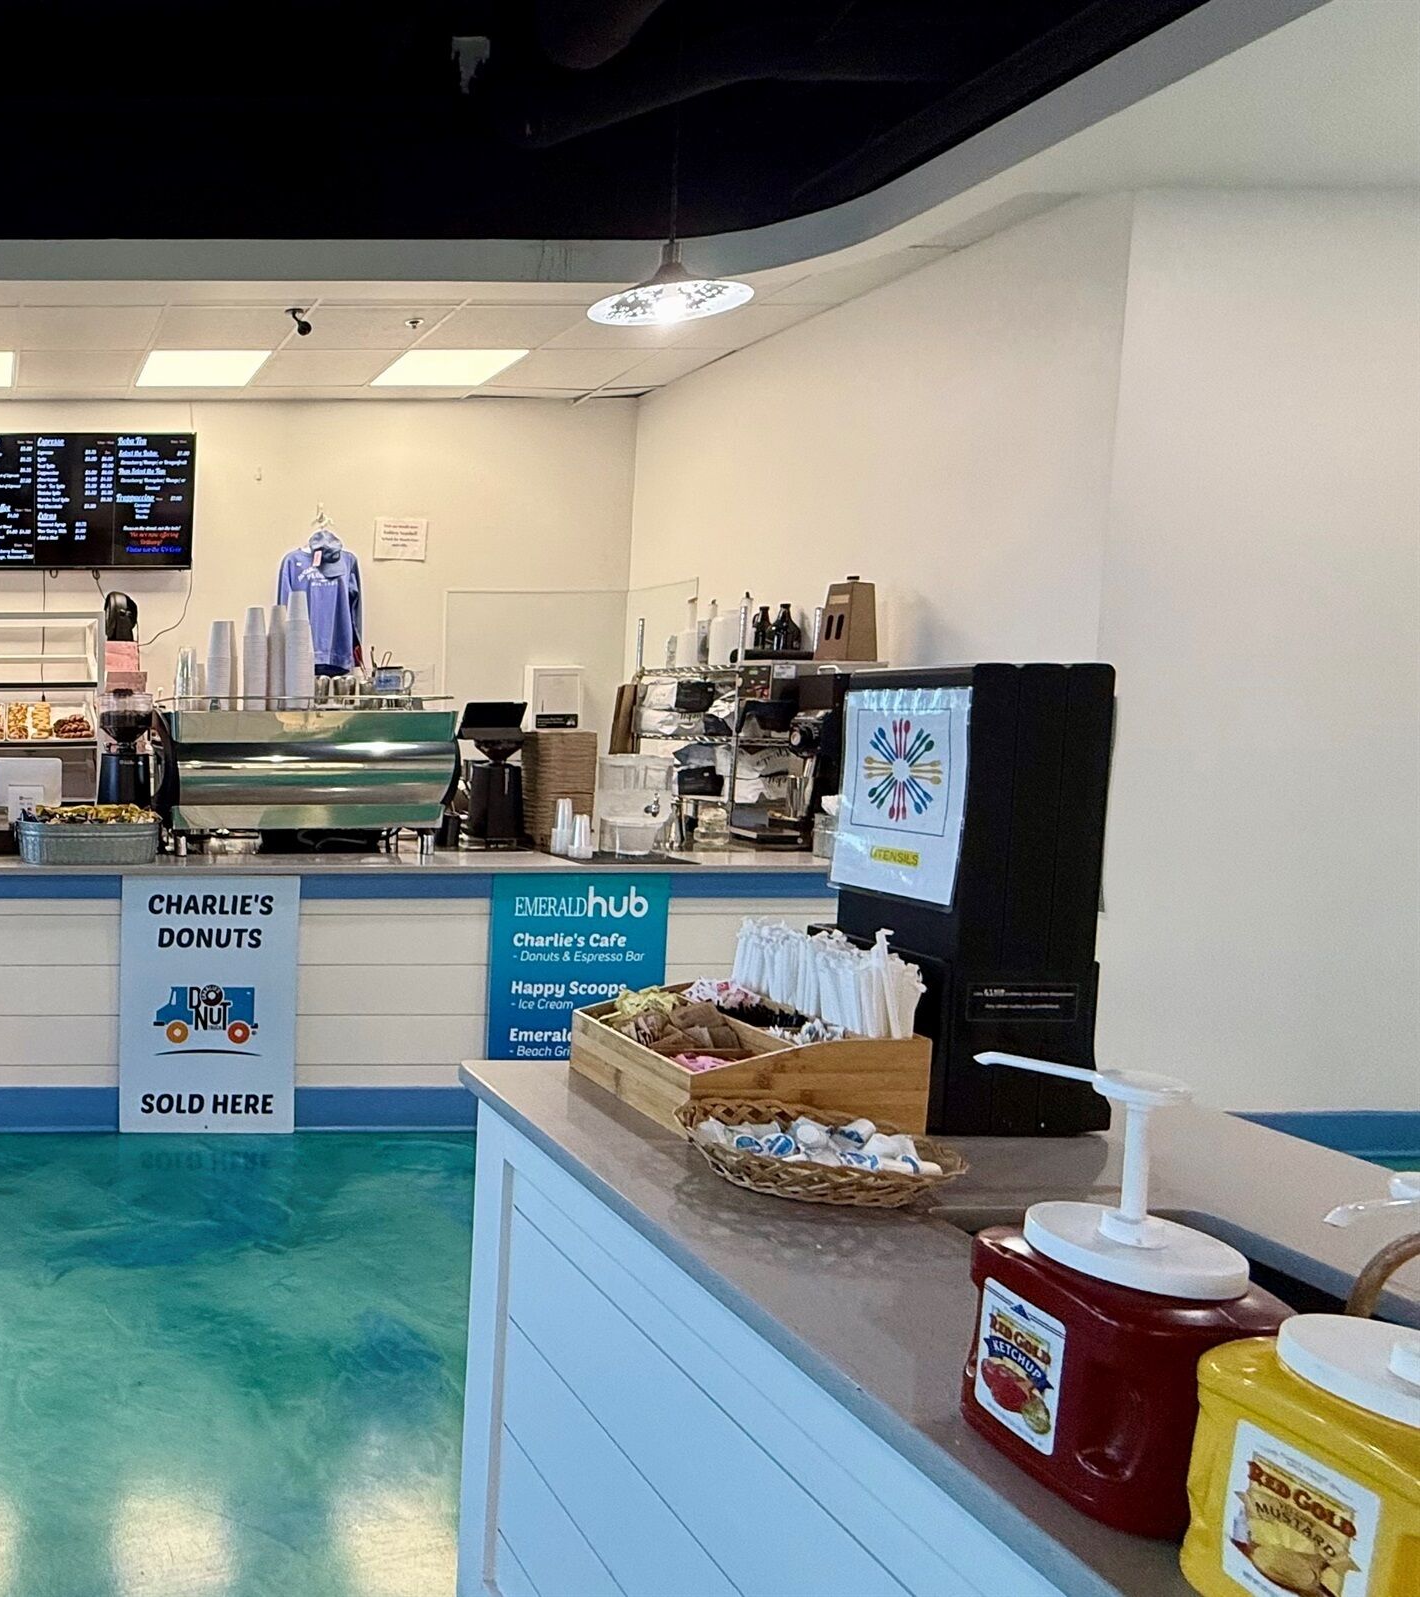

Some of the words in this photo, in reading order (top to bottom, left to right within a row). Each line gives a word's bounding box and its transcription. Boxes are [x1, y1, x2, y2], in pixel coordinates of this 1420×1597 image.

[37, 437, 65, 447] Espresso
[135, 437, 147, 446] Tea
[148, 894, 274, 916] CHARLIE'S
[158, 928, 262, 949] DONUTS
[512, 932, 585, 948] Charlie's
[589, 932, 627, 948] Cafe
[520, 950, 560, 962] Donuts
[562, 951, 571, 962] &
[573, 951, 623, 964] Espresso
[625, 951, 645, 962] Bar
[510, 980, 566, 998] Happy
[568, 981, 627, 998] Scoops
[518, 999, 535, 1010] Ice
[537, 999, 574, 1010] Cream
[516, 1046, 552, 1057] Beach
[141, 1093, 205, 1114] SOLD
[212, 1094, 274, 1114] HERE
[993, 1339, 1042, 1379] KETCHUP
[1255, 1501, 1336, 1558] MUSTARD
